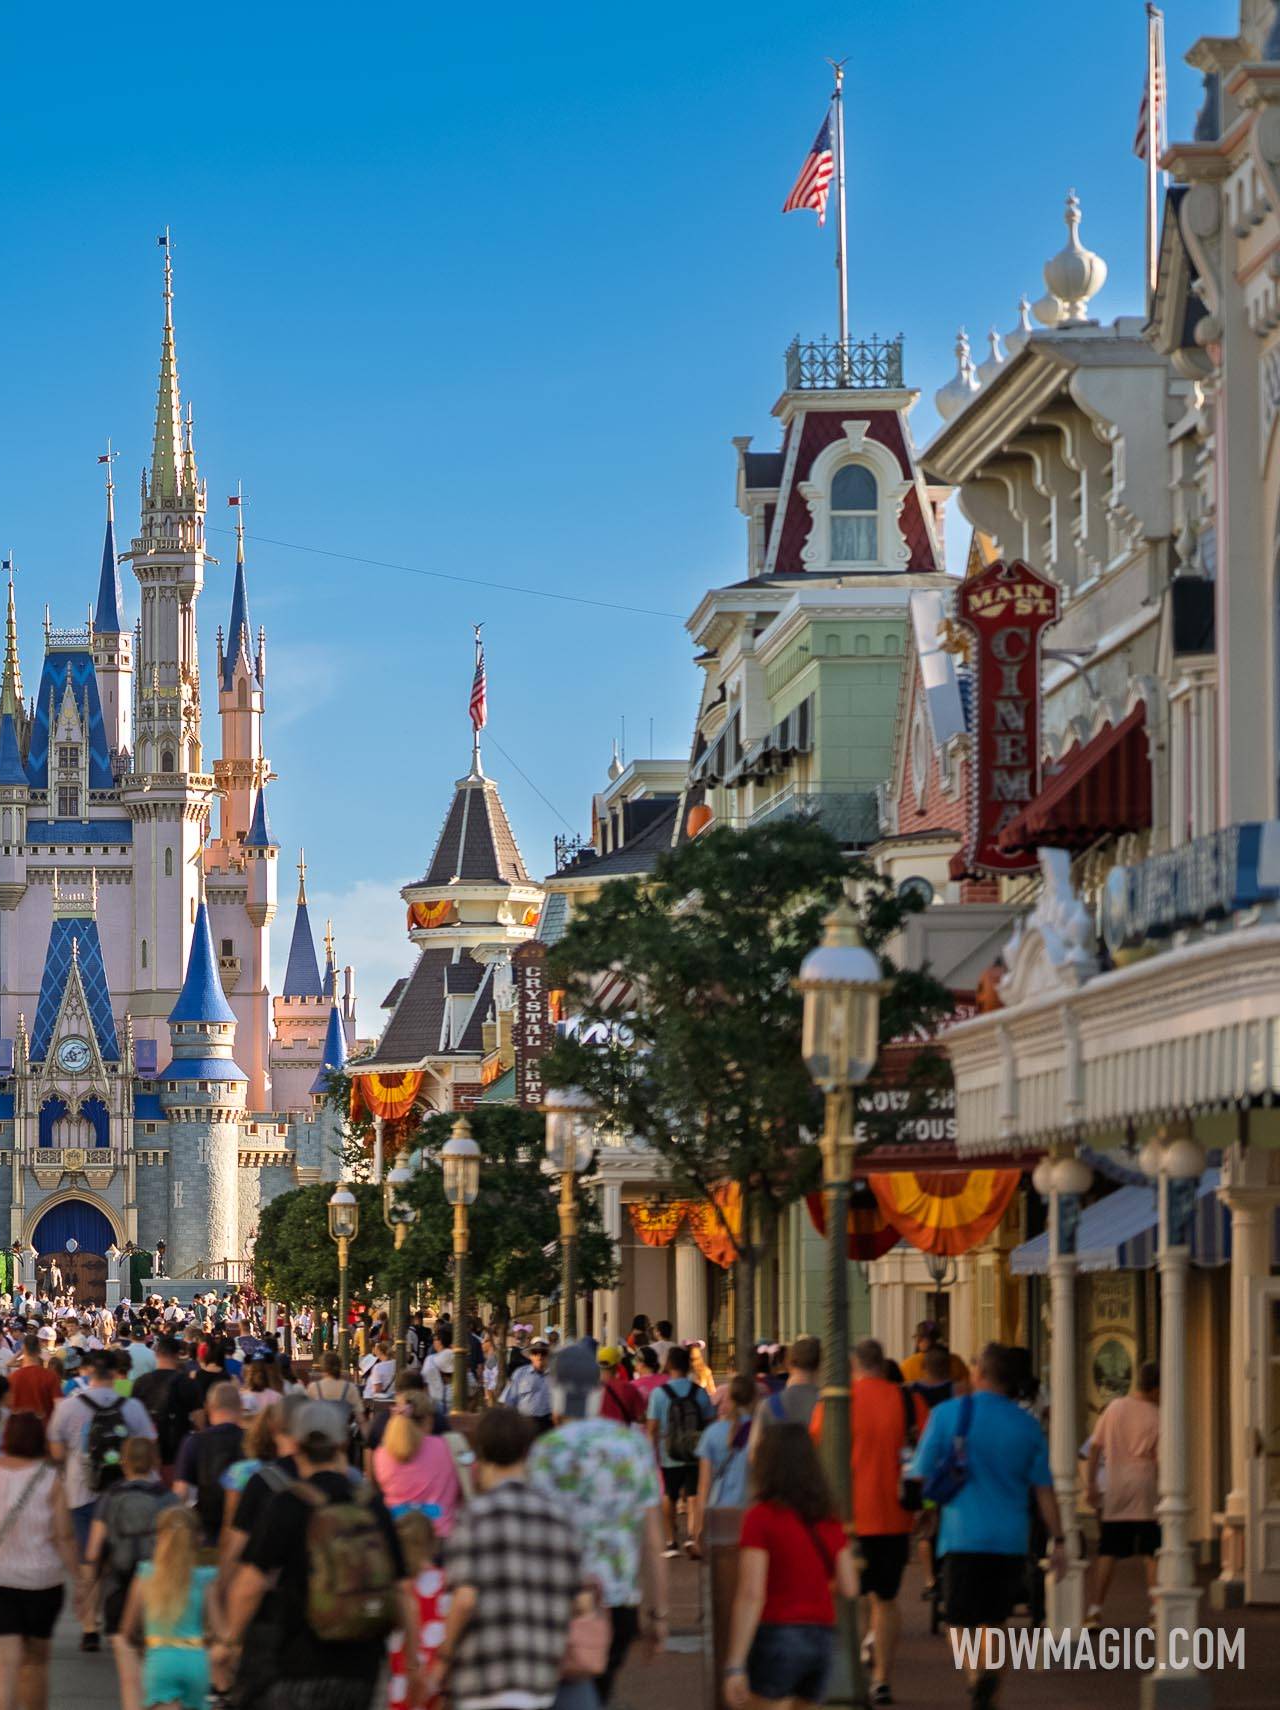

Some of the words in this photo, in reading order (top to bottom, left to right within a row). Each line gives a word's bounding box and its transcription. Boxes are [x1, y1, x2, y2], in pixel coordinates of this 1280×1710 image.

[968, 584, 1045, 612] MAIN
[524, 966, 543, 1047] CRYSTAL
[524, 1058, 543, 1104] ARTS
